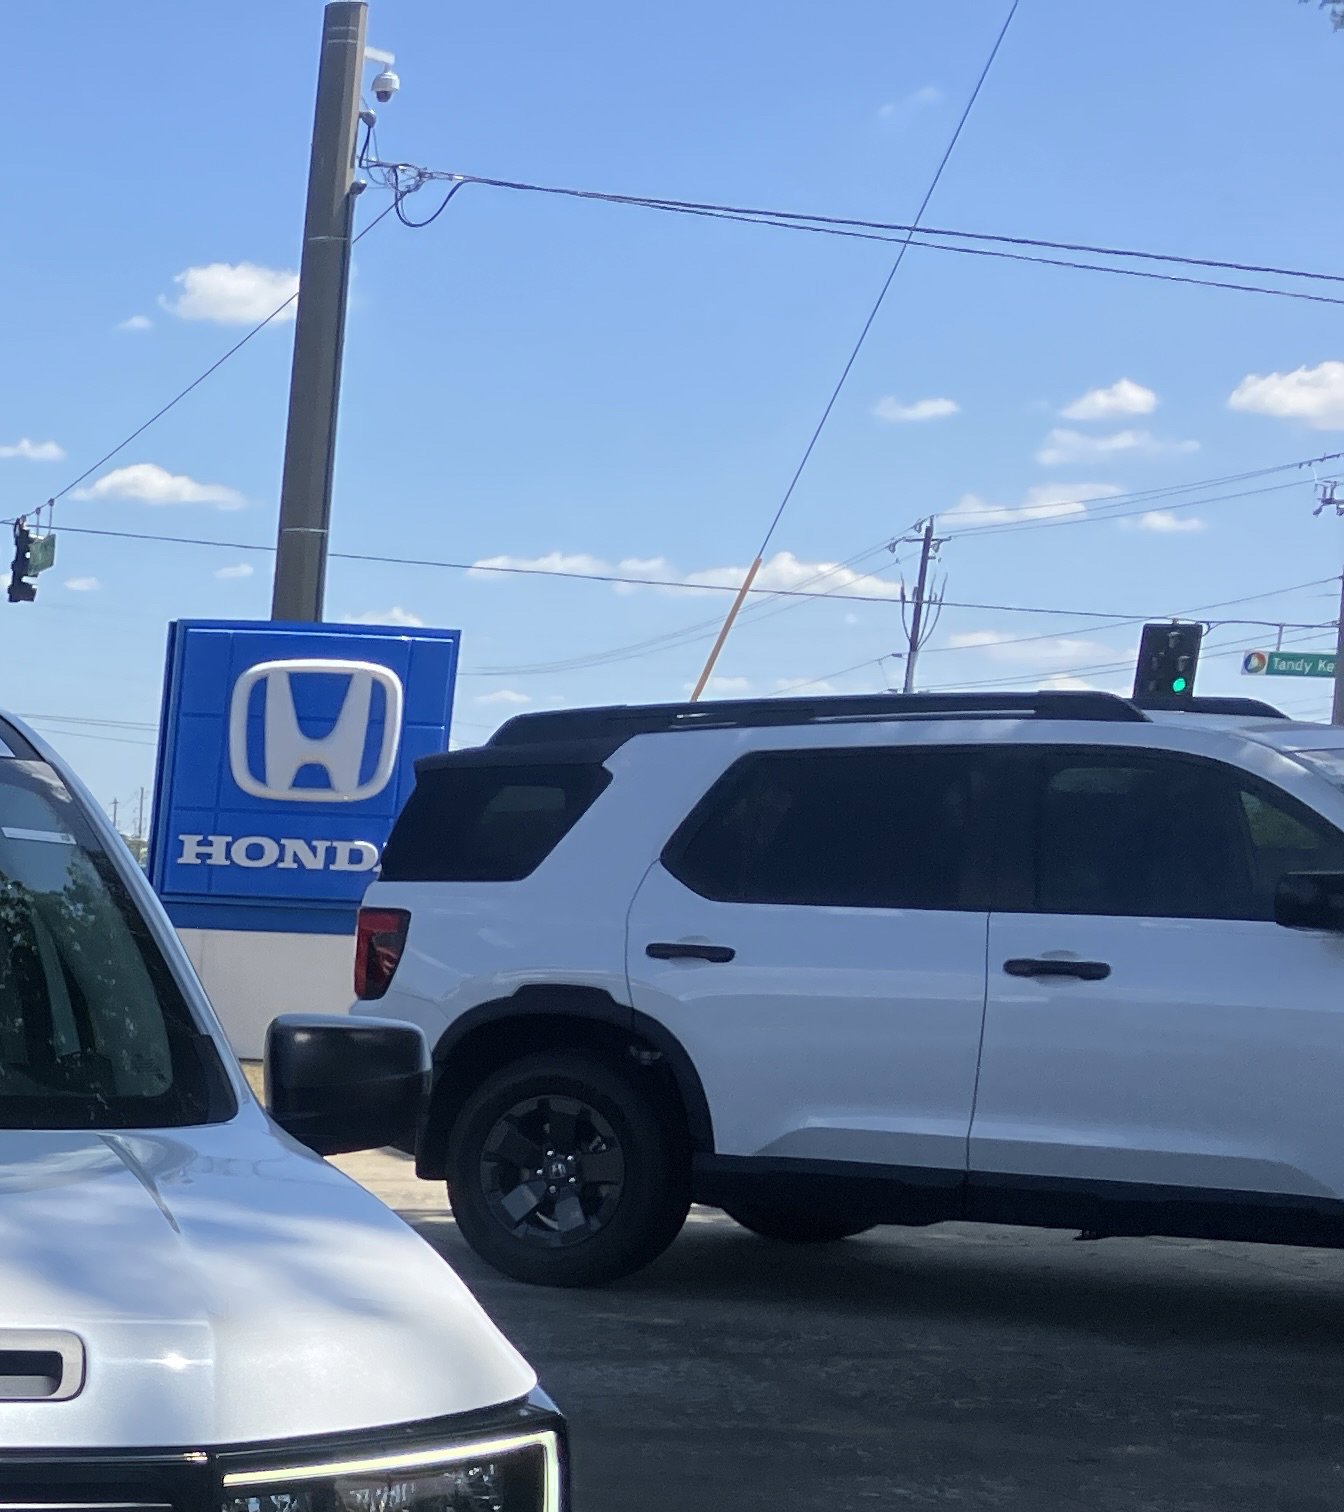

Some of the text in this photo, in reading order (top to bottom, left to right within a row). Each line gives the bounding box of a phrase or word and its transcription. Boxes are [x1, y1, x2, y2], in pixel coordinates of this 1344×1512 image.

[1272, 657, 1336, 675] Tandy Ke
[177, 834, 383, 873] HOND
